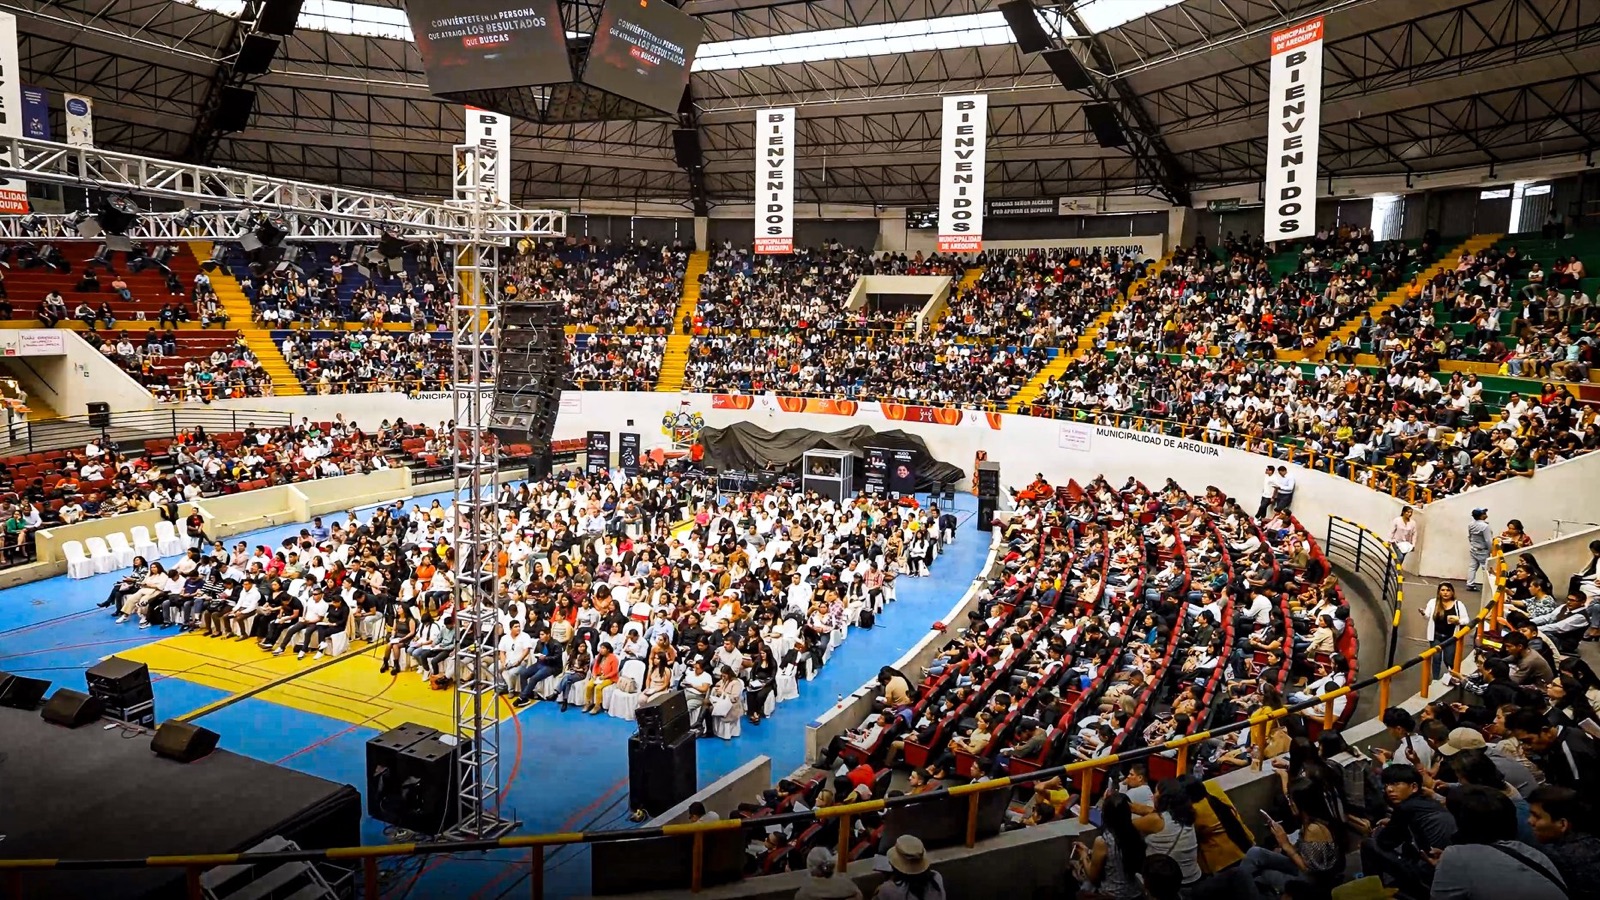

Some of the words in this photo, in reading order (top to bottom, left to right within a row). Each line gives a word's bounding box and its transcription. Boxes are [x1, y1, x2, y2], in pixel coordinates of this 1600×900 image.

[431, 15, 480, 28] CONVIÉRTETE
[499, 7, 535, 20] PERSONA
[441, 29, 466, 38] ATRAIGA
[466, 24, 484, 35] LOS
[486, 17, 547, 33] RESULTADOS
[466, 38, 478, 46] QUE
[479, 34, 509, 44] BUSCAS
[617, 18, 652, 40] CONVIÉRTETE
[662, 40, 684, 55] PERSONA
[1273, 20, 1321, 43] MUNICIPALIDAD
[1276, 42, 1285, 50] DE
[1285, 31, 1317, 48] AREQUIPA
[609, 27, 619, 37] QUE
[637, 38, 650, 50] LOS
[650, 44, 686, 66] RESULTADOS
[640, 51, 661, 65] BUSCAS
[1278, 51, 1307, 233] BIENVENIDOS
[766, 113, 785, 235] BIENVENIDOS
[951, 100, 975, 232] BIENVENIDOS
[939, 235, 981, 243] MUNICIPALIDAD
[1096, 427, 1161, 445] MUNICIPALIDAD
[1163, 439, 1175, 448] DE
[1177, 441, 1219, 457] AREQUIPA
